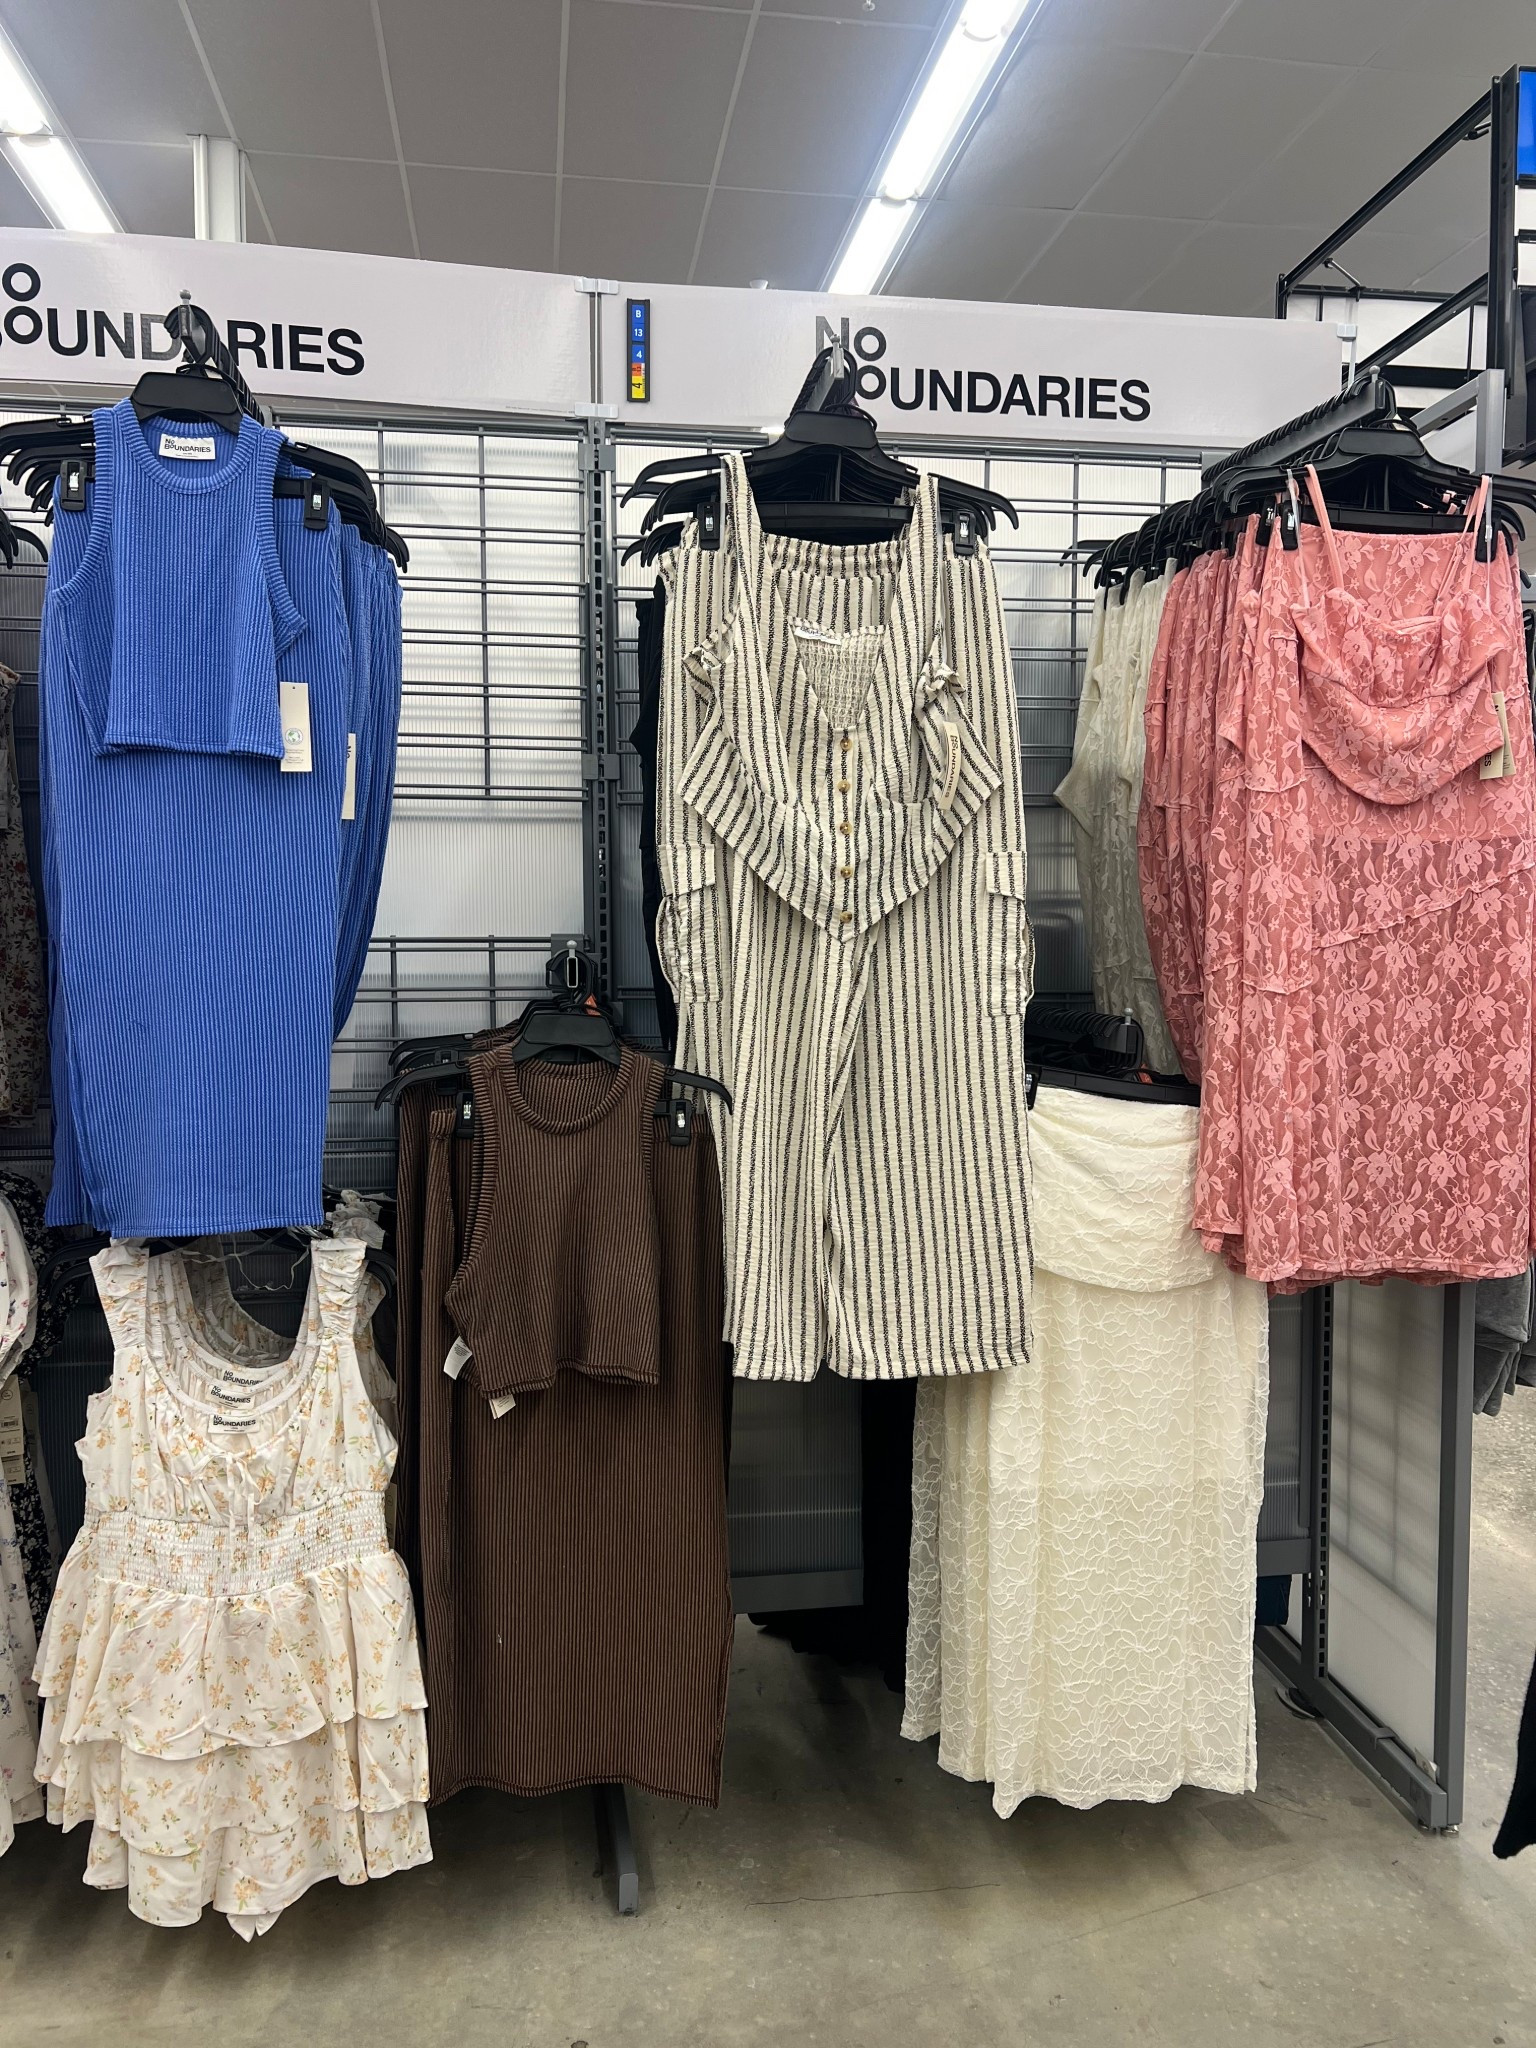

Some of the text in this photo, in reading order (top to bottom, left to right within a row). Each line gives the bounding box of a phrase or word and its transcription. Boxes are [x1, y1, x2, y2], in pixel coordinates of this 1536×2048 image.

[635, 309, 642, 318] B
[634, 328, 643, 337] 13
[0, 306, 365, 376] OUNDRIES
[636, 350, 642, 359] 4
[856, 365, 1151, 421] OUNDARIES
